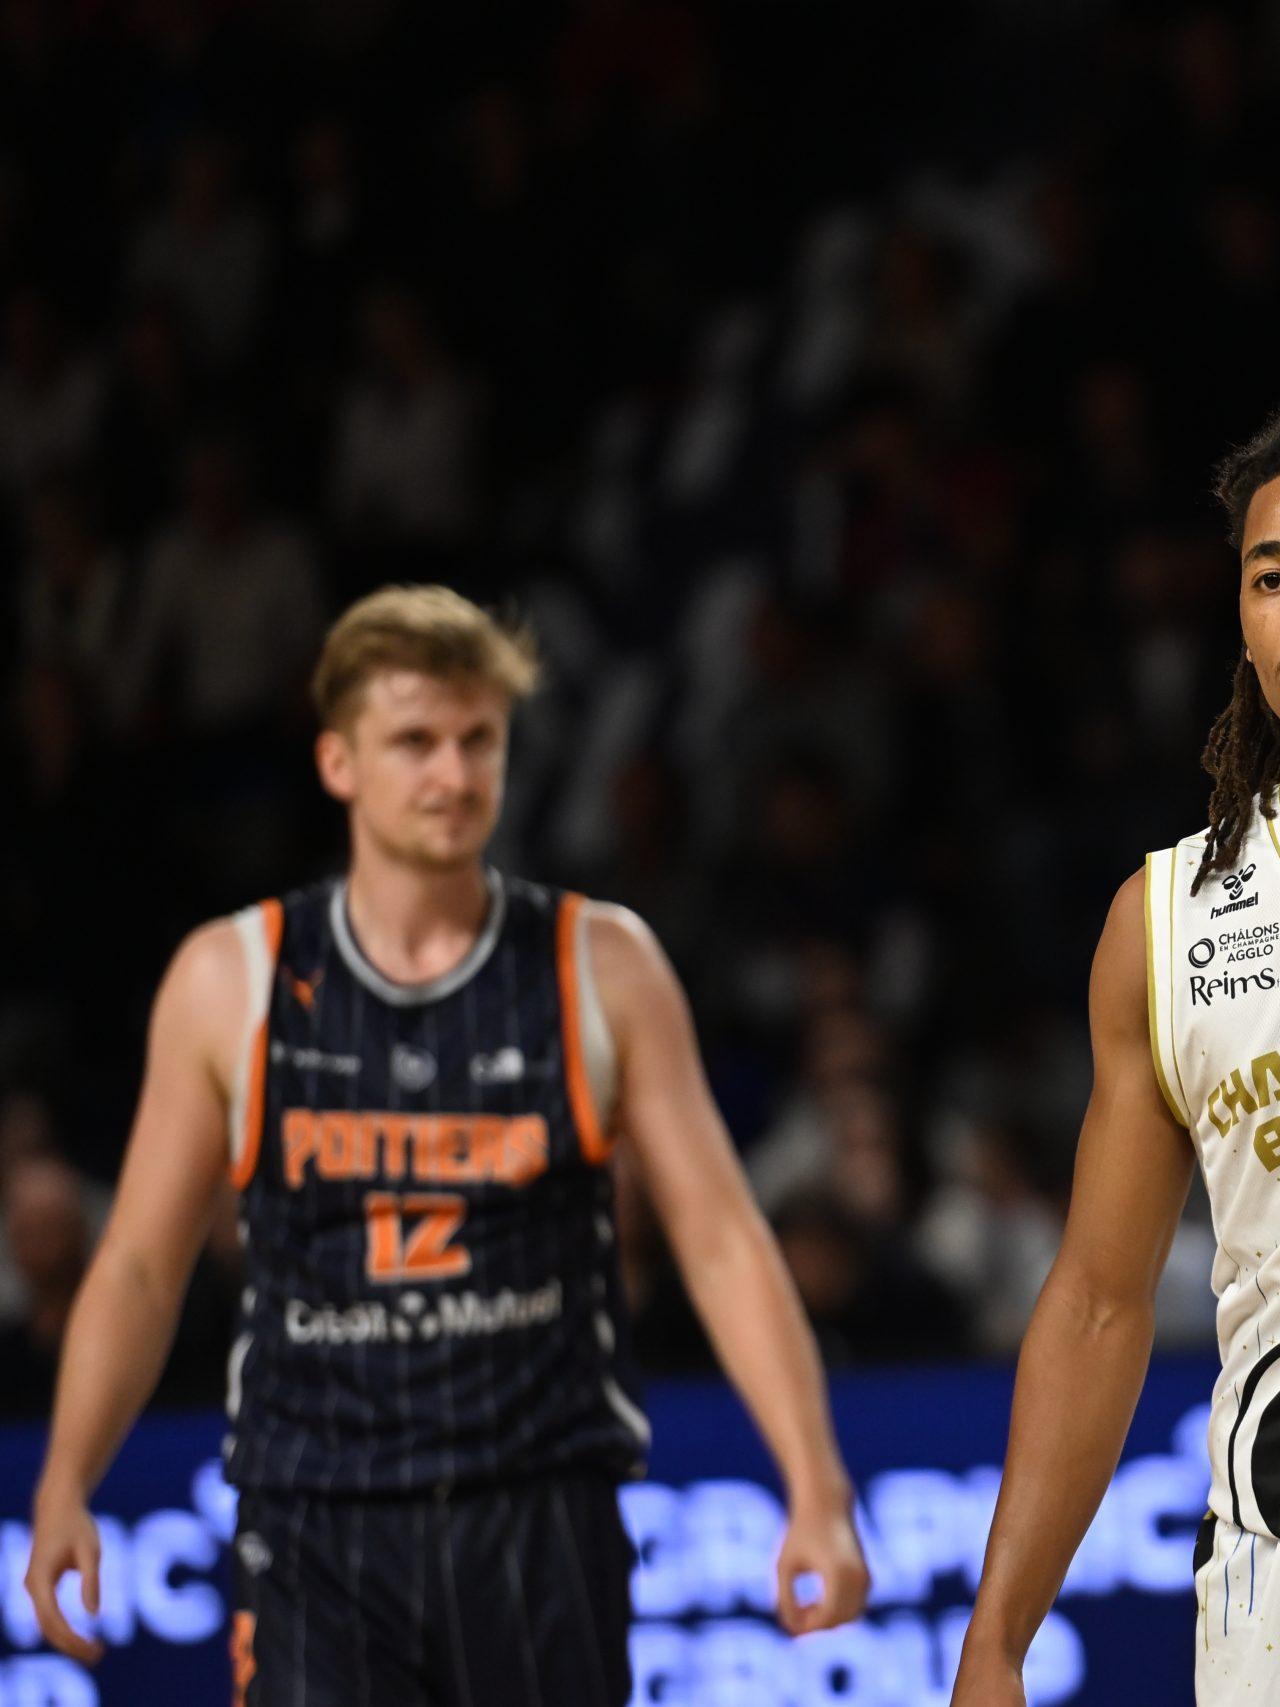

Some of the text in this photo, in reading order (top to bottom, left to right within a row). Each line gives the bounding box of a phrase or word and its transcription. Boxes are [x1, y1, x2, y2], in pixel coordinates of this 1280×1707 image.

[1210, 891, 1259, 919] hummel
[1219, 933, 1280, 952] EN CHAMPAGNE
[1226, 943, 1274, 964] AGGLO
[282, 1108, 549, 1190] POITIERS
[364, 1191, 472, 1283] 12
